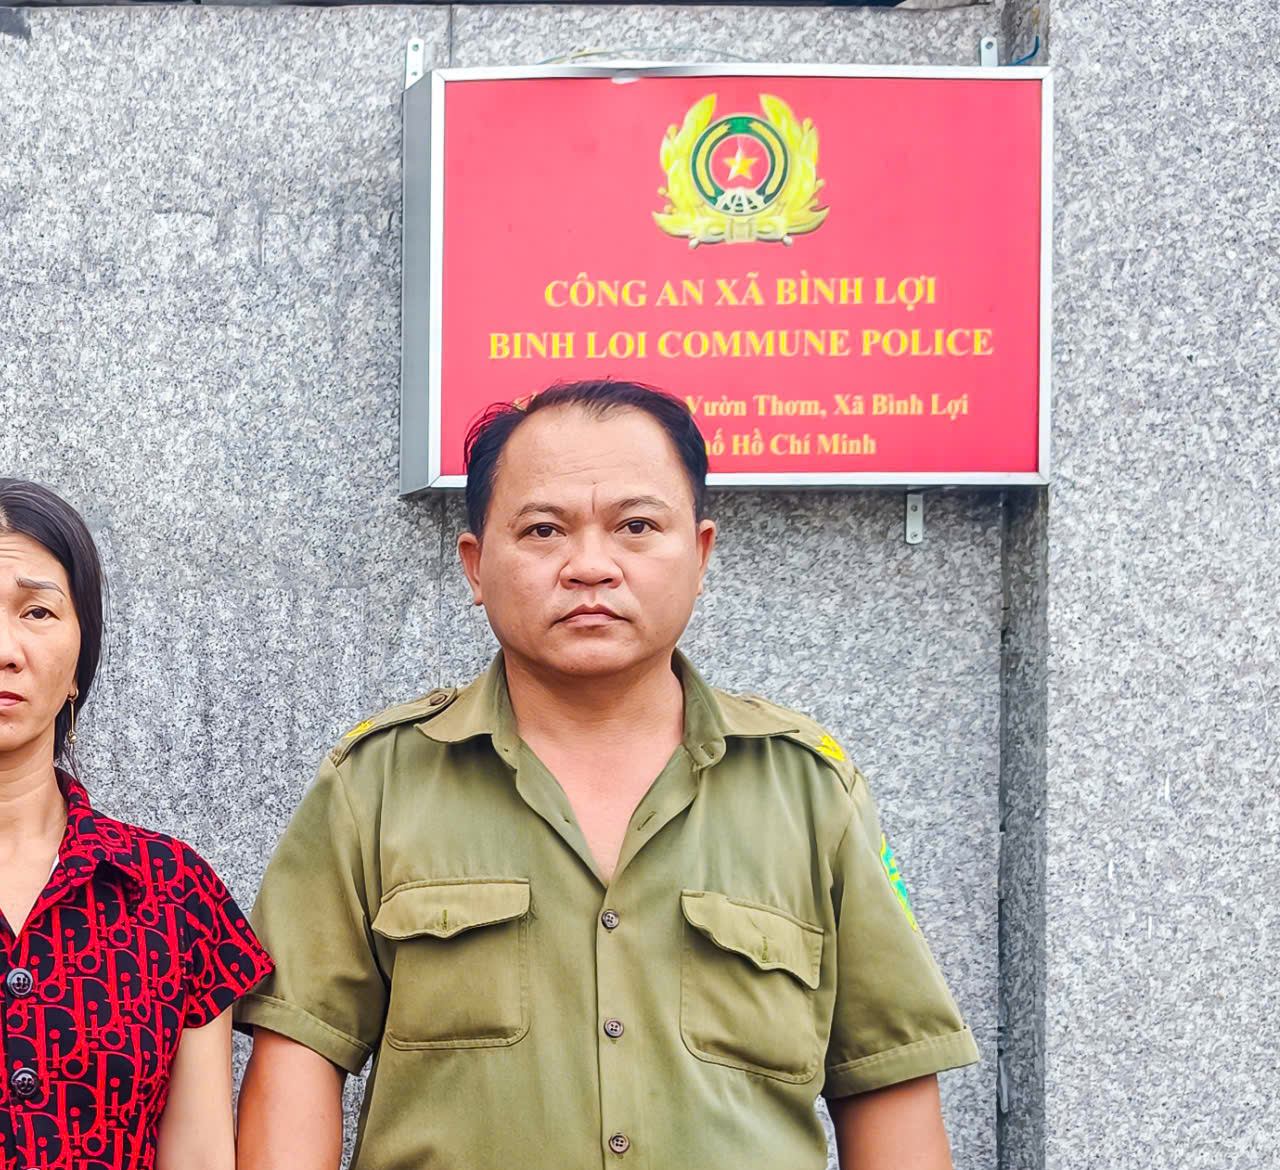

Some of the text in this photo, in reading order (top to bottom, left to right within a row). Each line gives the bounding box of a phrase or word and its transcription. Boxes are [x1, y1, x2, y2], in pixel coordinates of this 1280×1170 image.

[544, 269, 936, 312] CÔNG AN XÃ BÌNH LỢI
[489, 328, 994, 360] BINH LOI COMMUNE POLICE
[753, 393, 828, 419] Thơm,
[833, 393, 865, 416] Xã
[871, 393, 924, 416] Bình
[931, 392, 969, 421] Lợi
[732, 427, 765, 456] Hồ
[770, 433, 811, 456] Chí
[817, 432, 877, 456] Minh
